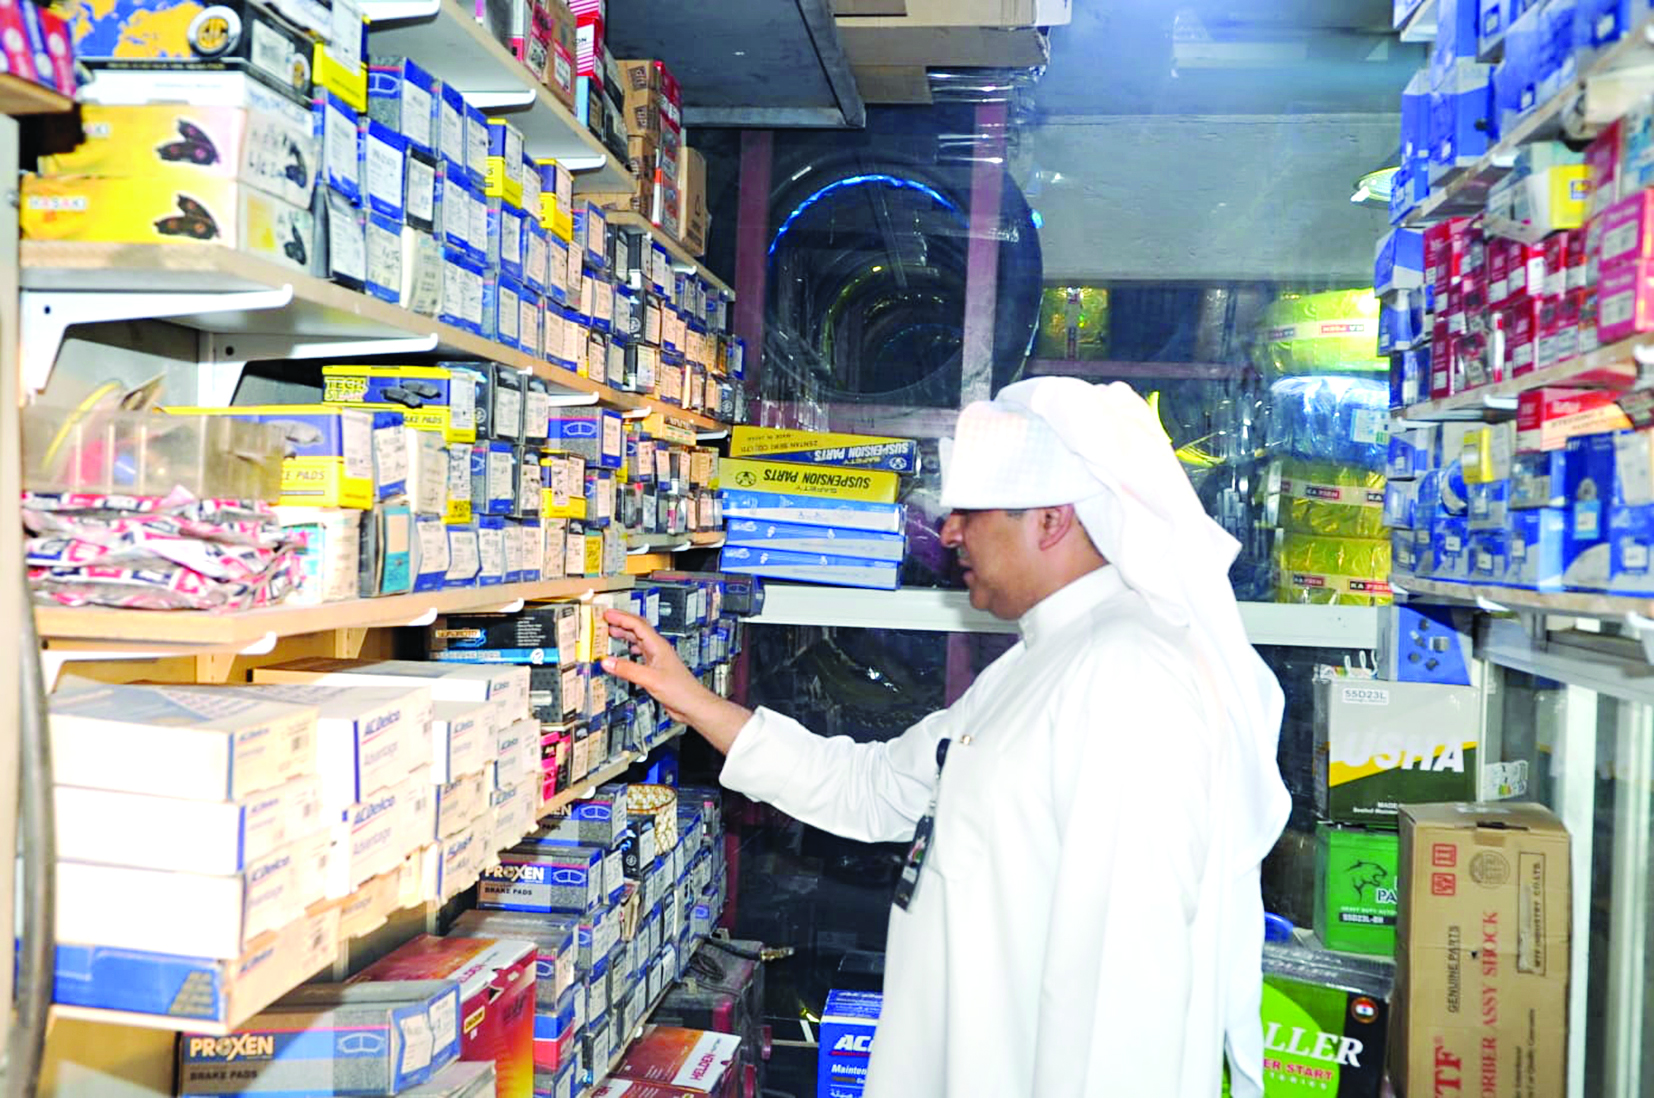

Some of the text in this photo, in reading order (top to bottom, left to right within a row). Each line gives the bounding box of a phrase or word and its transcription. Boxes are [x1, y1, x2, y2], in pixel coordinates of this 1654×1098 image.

[814, 442, 909, 462] SUSPENSION PARTS
[296, 470, 325, 480] PADS
[763, 468, 872, 489] SUSPENSION PARTS
[1341, 732, 1465, 773] USHA
[484, 865, 545, 882] PROXEN
[484, 886, 533, 897] BRAKE PADS
[1482, 911, 1499, 977] SHOCK
[1447, 925, 1460, 1014] GENUINE PARTS
[1482, 983, 1498, 1026] ASSY
[189, 1033, 274, 1061] PROXEN
[1286, 1064, 1333, 1080] START
[1434, 1045, 1462, 1098] TF
